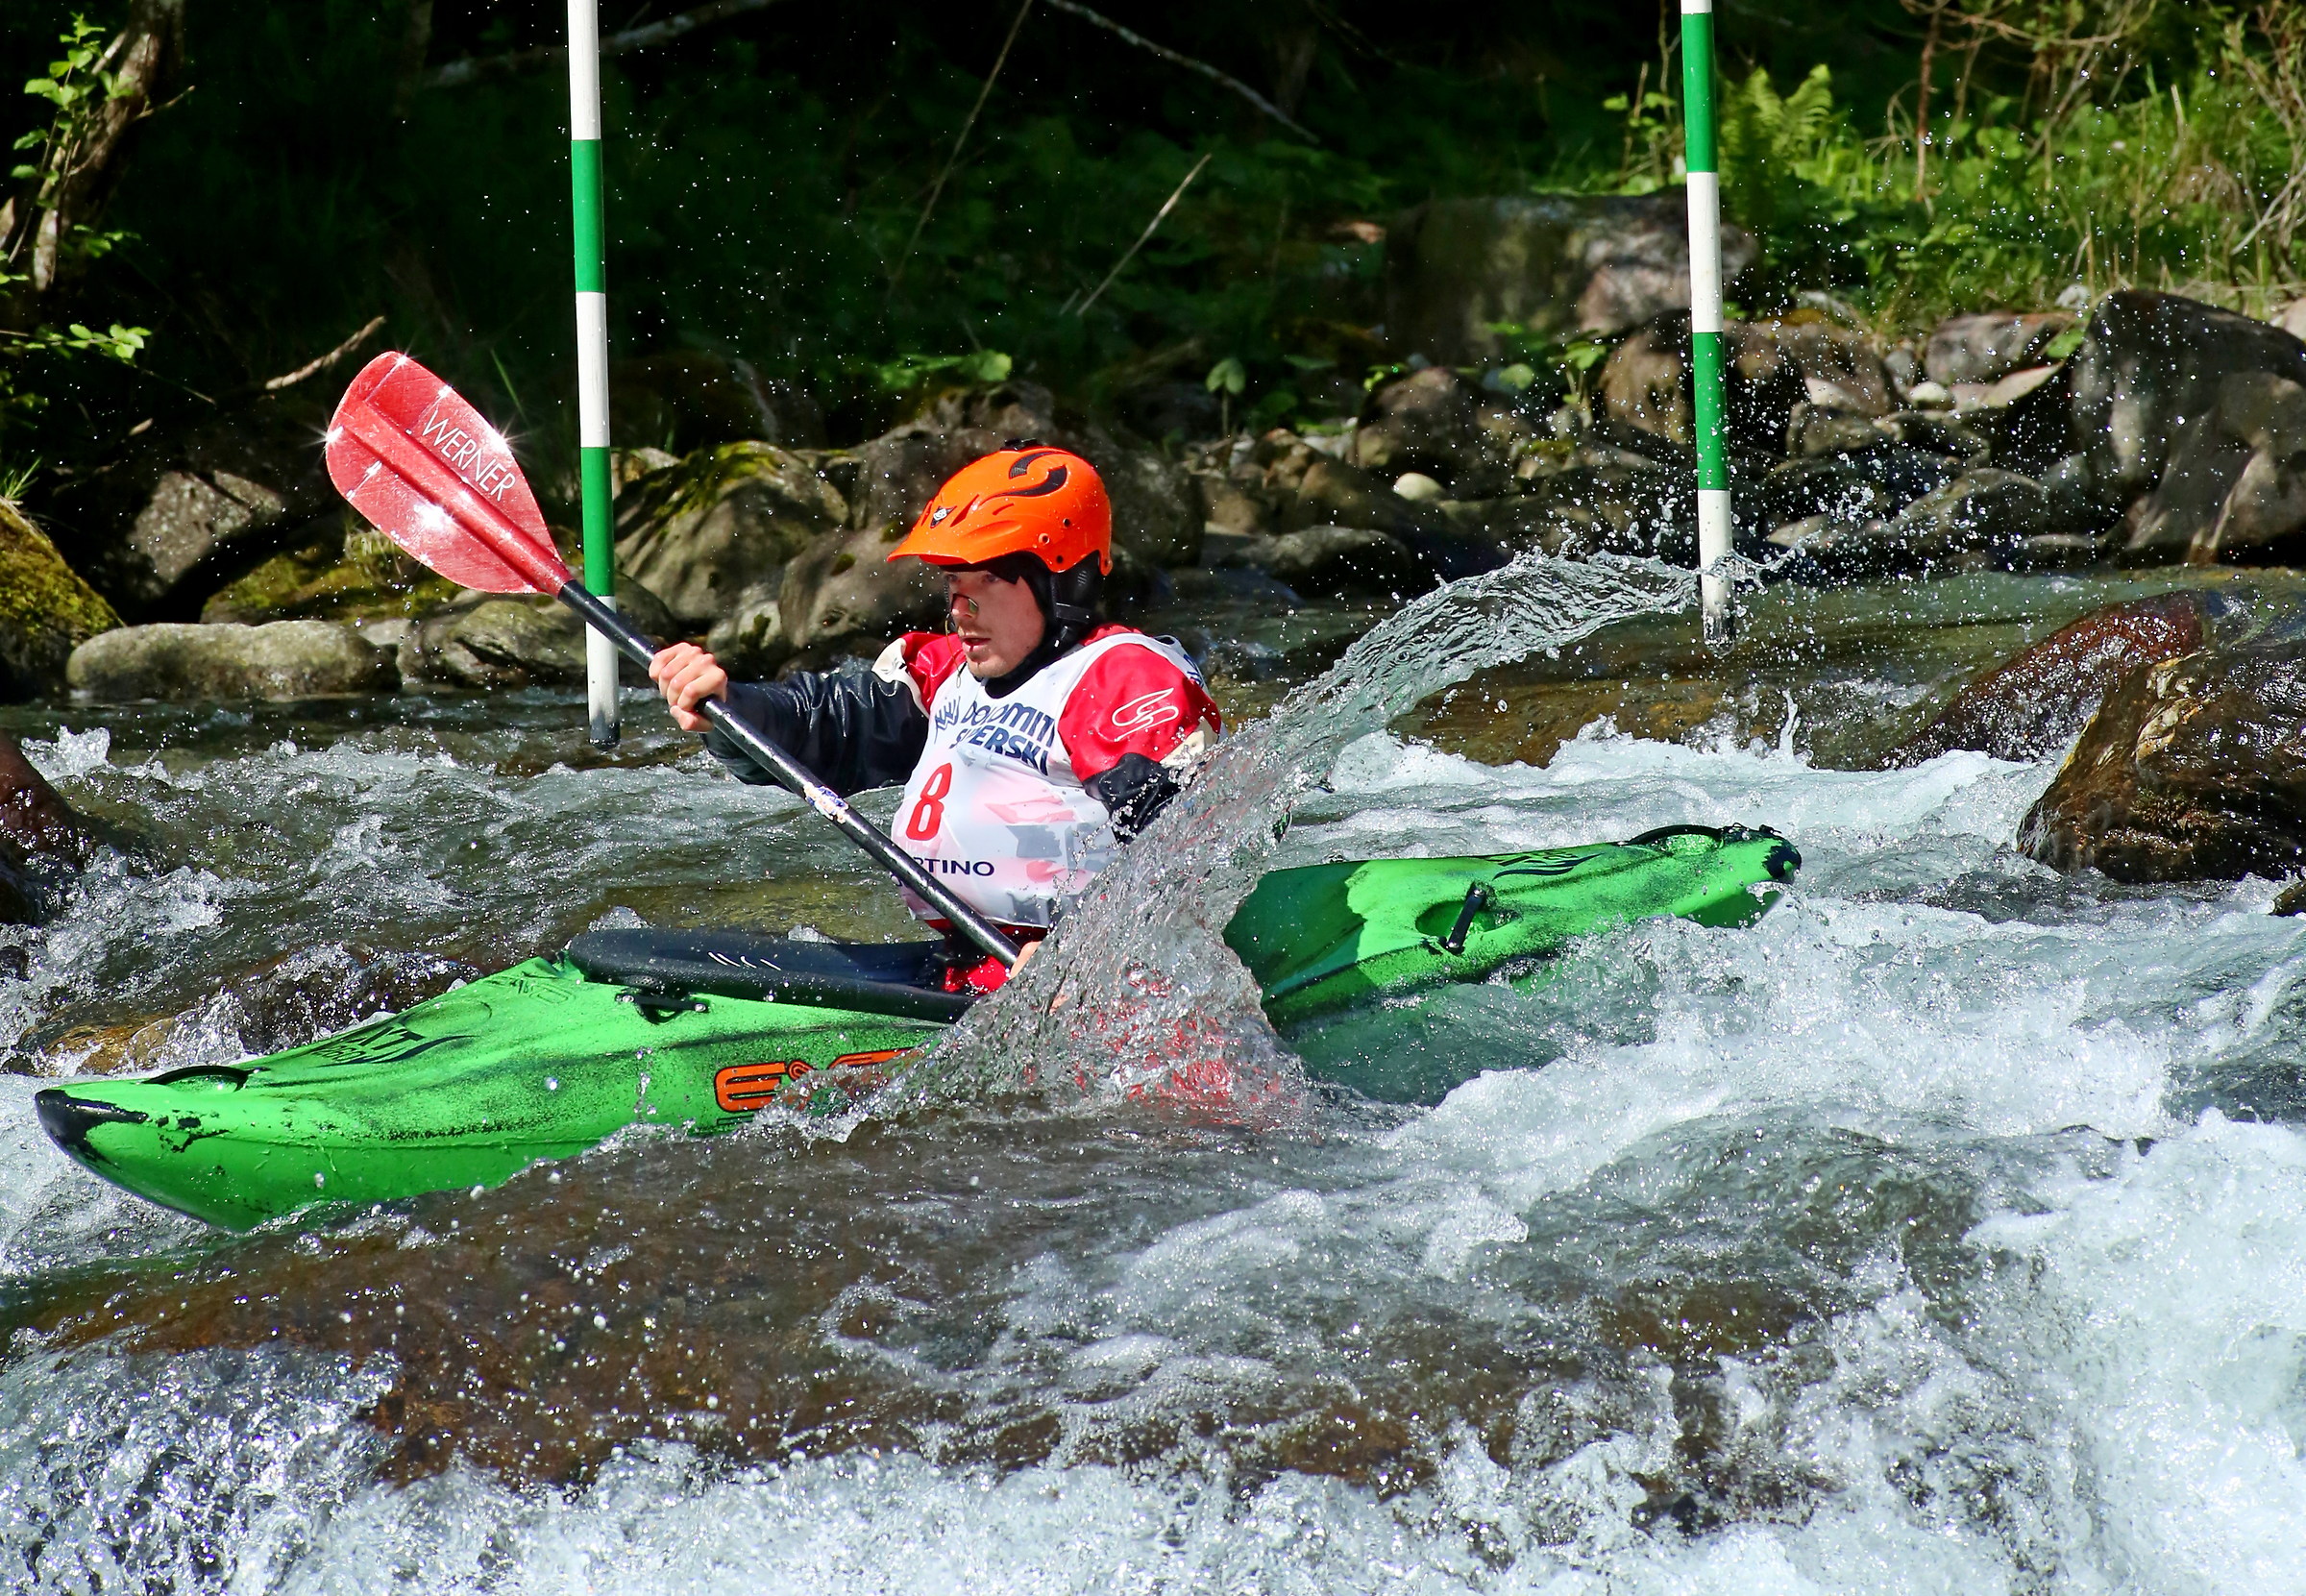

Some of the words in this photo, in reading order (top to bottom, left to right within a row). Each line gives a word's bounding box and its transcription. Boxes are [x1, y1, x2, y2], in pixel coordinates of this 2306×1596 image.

[422, 409, 516, 503] WERNER
[949, 724, 1048, 776] SERSKI
[906, 762, 952, 841] 8
